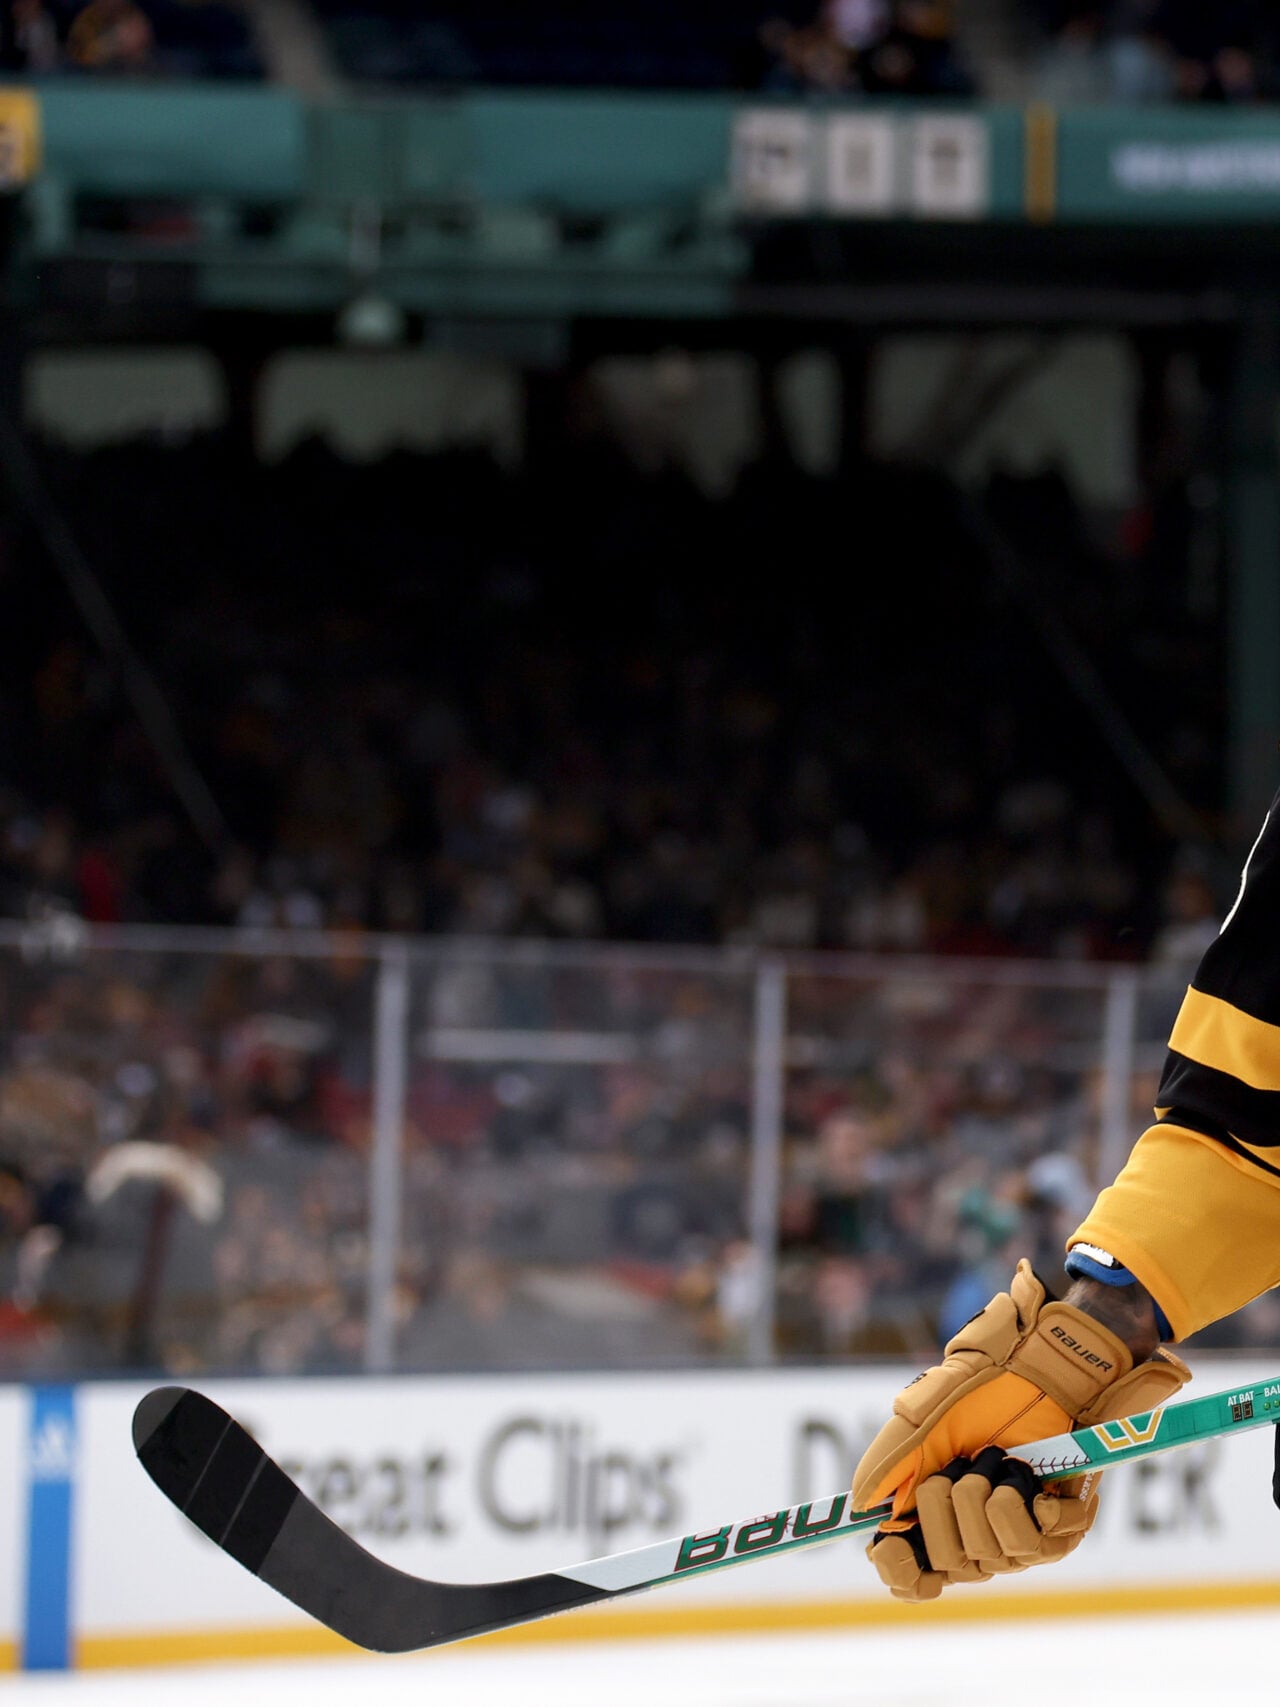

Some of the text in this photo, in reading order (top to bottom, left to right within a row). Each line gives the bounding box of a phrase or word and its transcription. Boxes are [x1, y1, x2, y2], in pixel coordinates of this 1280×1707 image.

[1227, 1394, 1238, 1407] AT
[1239, 1390, 1255, 1404] BAT
[477, 1412, 685, 1559] Clips
